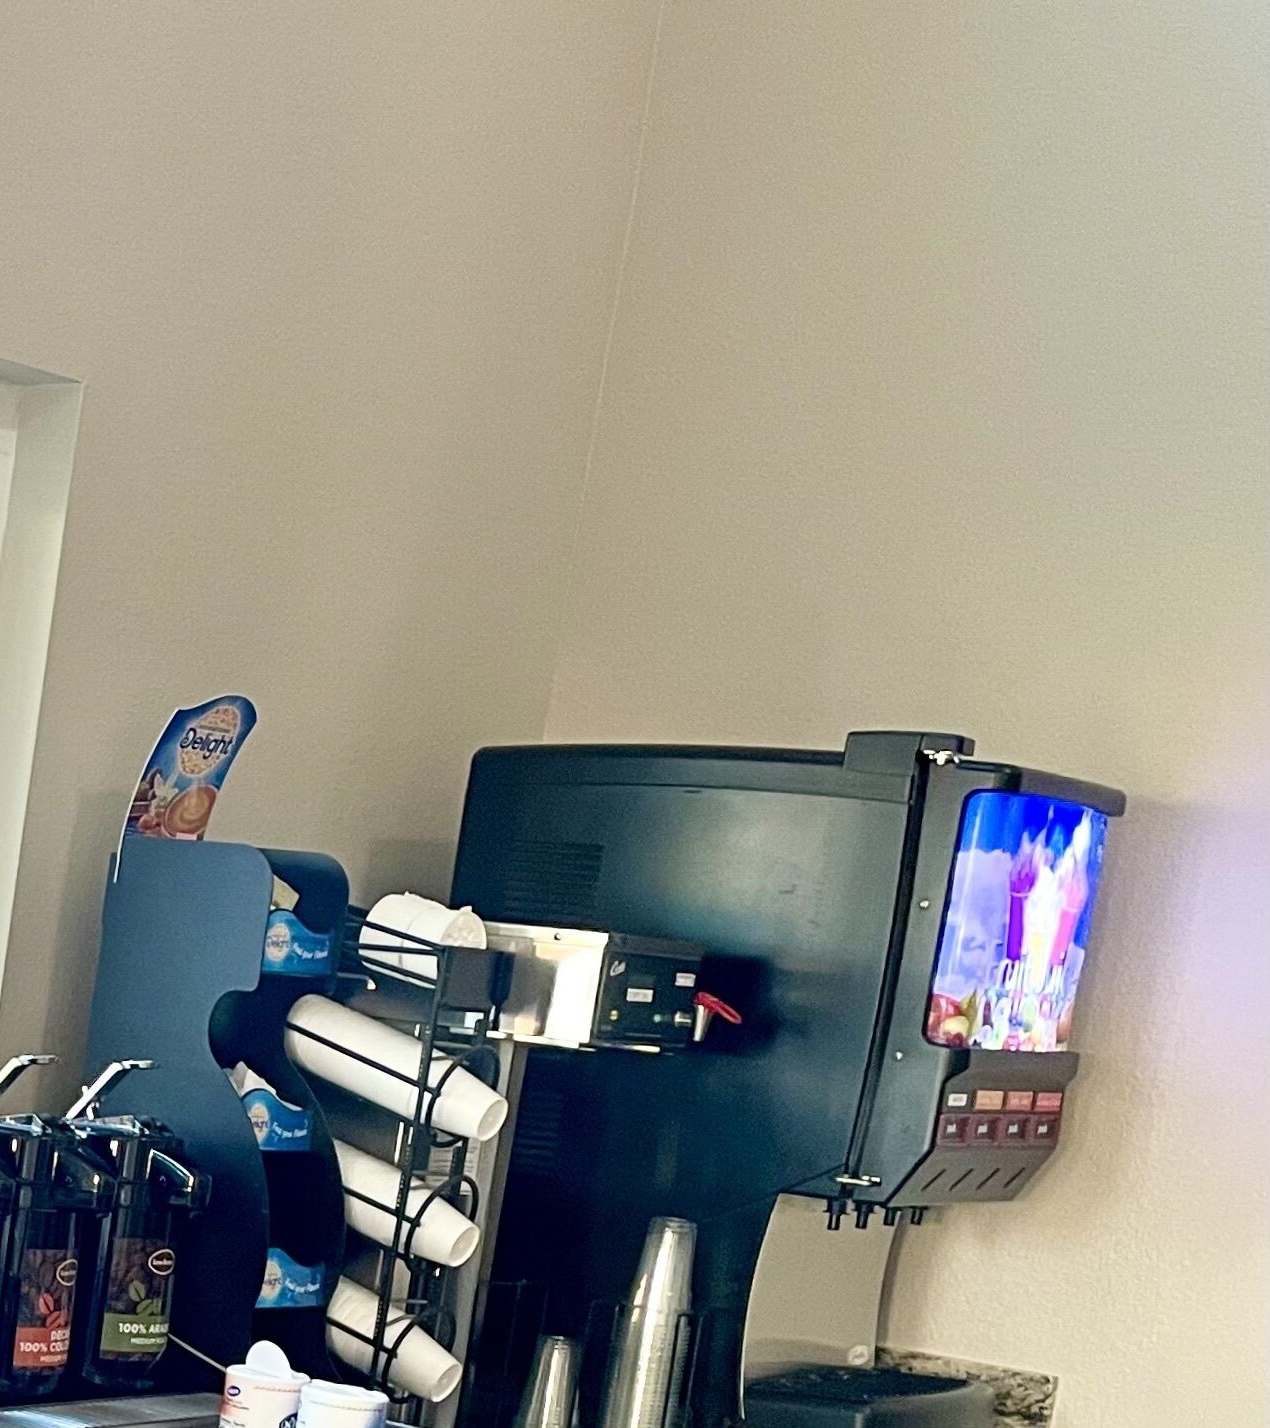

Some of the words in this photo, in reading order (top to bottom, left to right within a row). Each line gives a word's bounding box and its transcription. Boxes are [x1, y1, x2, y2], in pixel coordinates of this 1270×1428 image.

[179, 727, 235, 760] Delight
[118, 1322, 146, 1334] 100%
[19, 1342, 48, 1353] 100%
